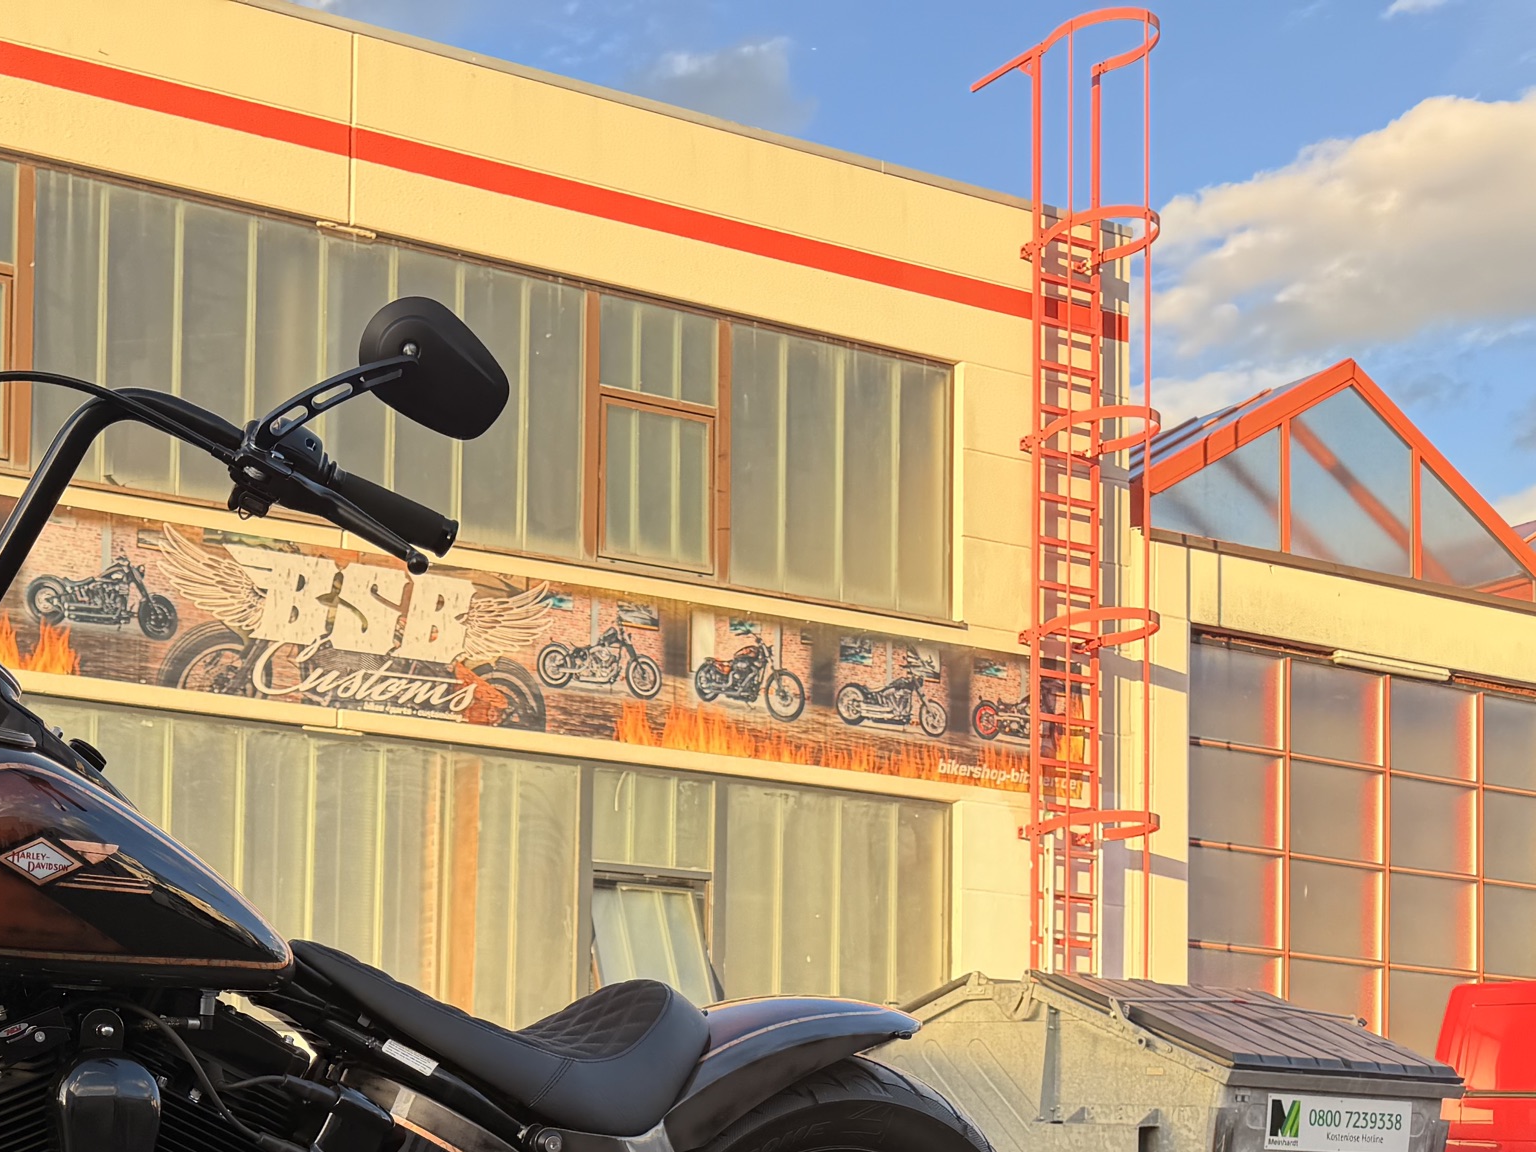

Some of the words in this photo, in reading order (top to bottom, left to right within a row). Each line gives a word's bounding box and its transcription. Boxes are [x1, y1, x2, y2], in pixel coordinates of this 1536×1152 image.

[224, 544, 477, 664] BSB
[252, 638, 478, 712] Customs
[12, 851, 50, 864] HARLEY-
[27, 861, 69, 873] DAVIDSON
[1309, 1109, 1342, 1127] 0800
[1345, 1111, 1402, 1130] 7239338
[1268, 1137, 1299, 1147] Meinhardt
[1326, 1132, 1360, 1142] Kostenlose
[1362, 1133, 1384, 1143] Hotline
